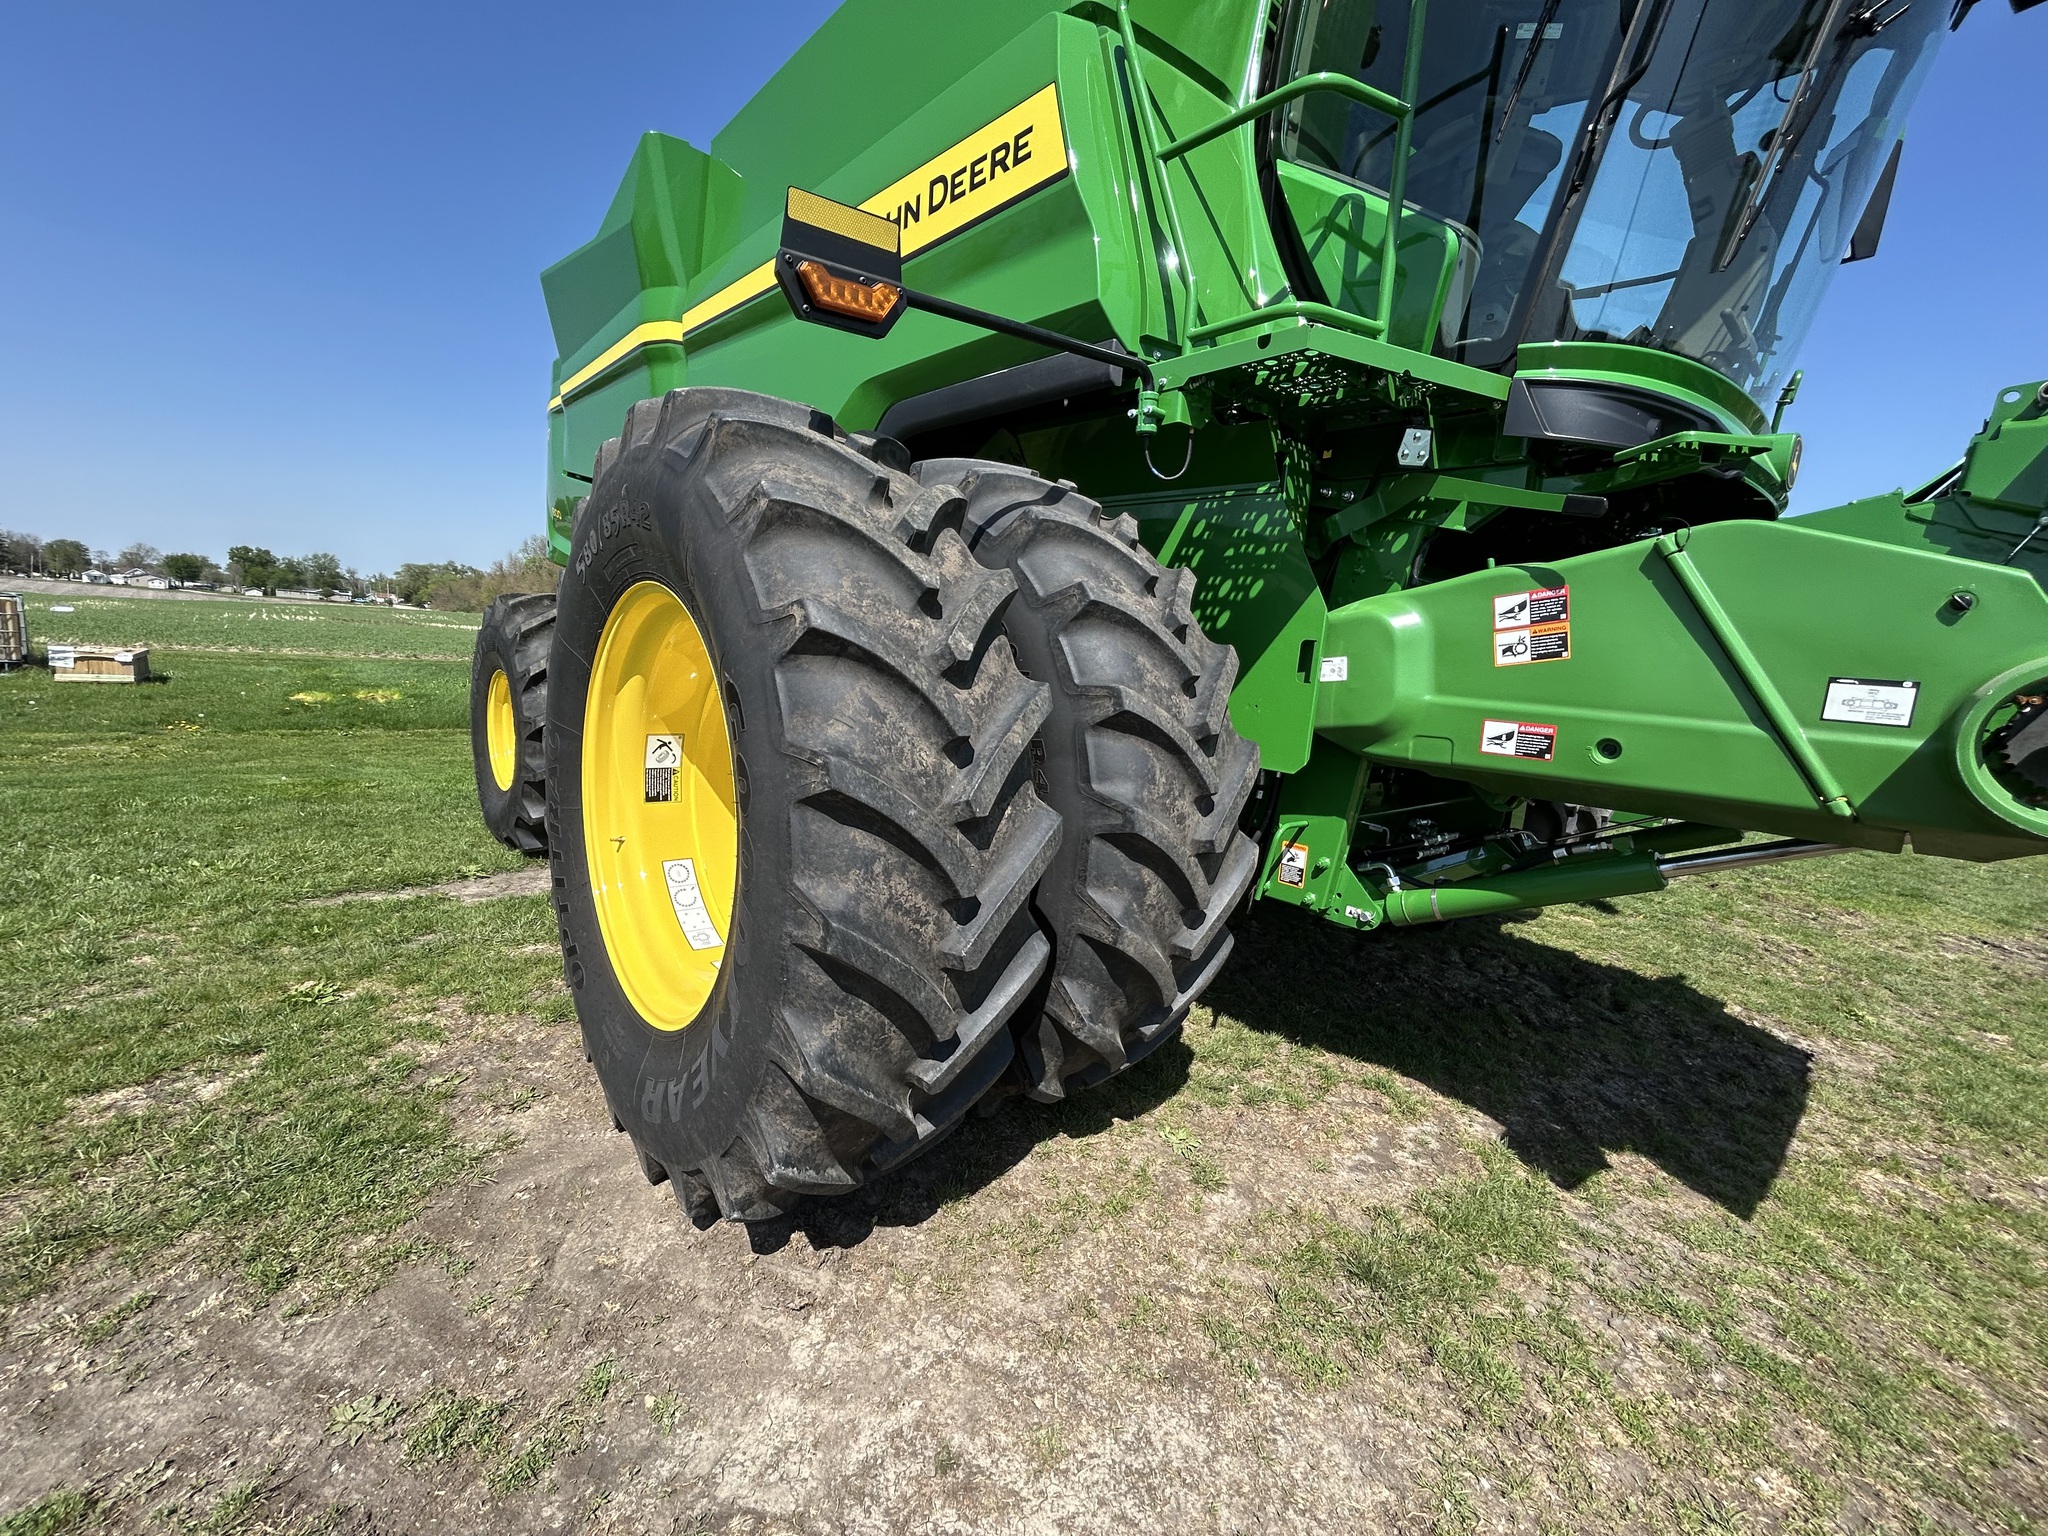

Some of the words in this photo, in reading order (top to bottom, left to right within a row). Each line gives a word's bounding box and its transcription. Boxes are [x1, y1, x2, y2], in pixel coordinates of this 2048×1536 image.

[886, 193, 921, 230] HN
[928, 124, 1034, 217] DEERE
[1537, 588, 1566, 598] DANGER
[1538, 625, 1567, 634] WARNING
[1525, 725, 1554, 734] DANGER
